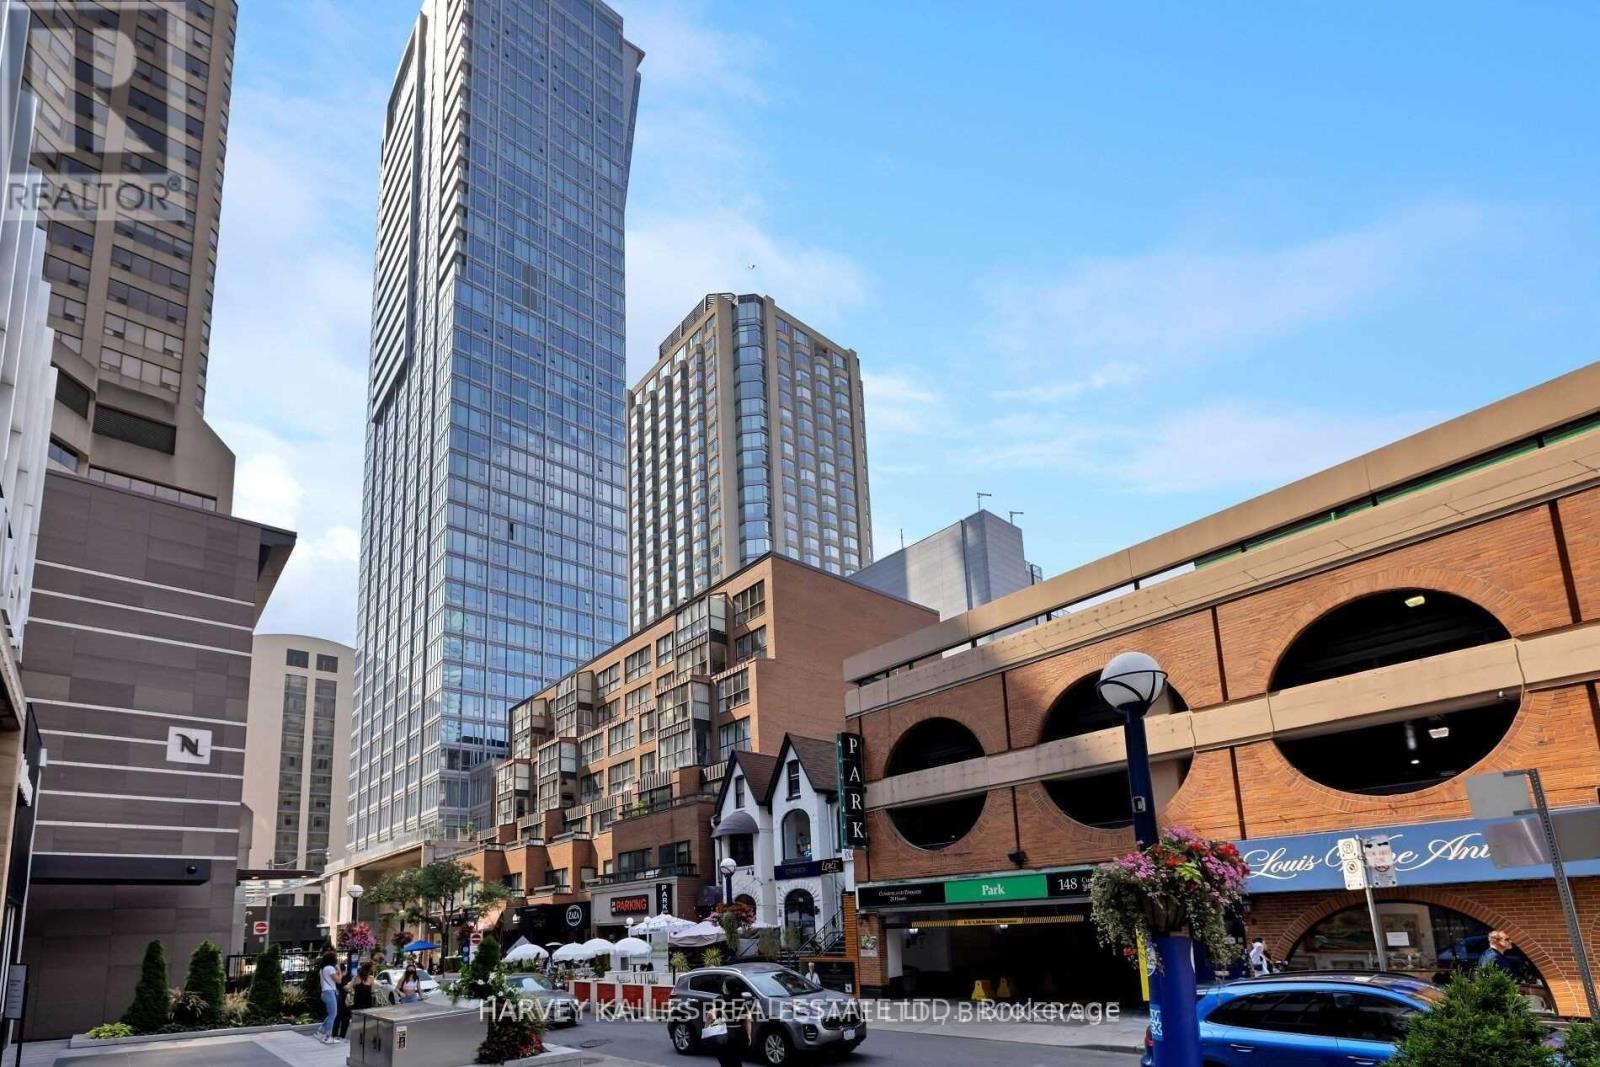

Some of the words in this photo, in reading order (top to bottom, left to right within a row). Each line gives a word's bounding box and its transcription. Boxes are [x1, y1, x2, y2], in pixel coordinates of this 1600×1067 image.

[175, 733, 205, 757] N
[848, 737, 864, 838] PARK
[1243, 847, 1322, 880] Louis
[981, 883, 1006, 896] Park
[1057, 877, 1078, 891] 148
[616, 898, 647, 912] PARKING
